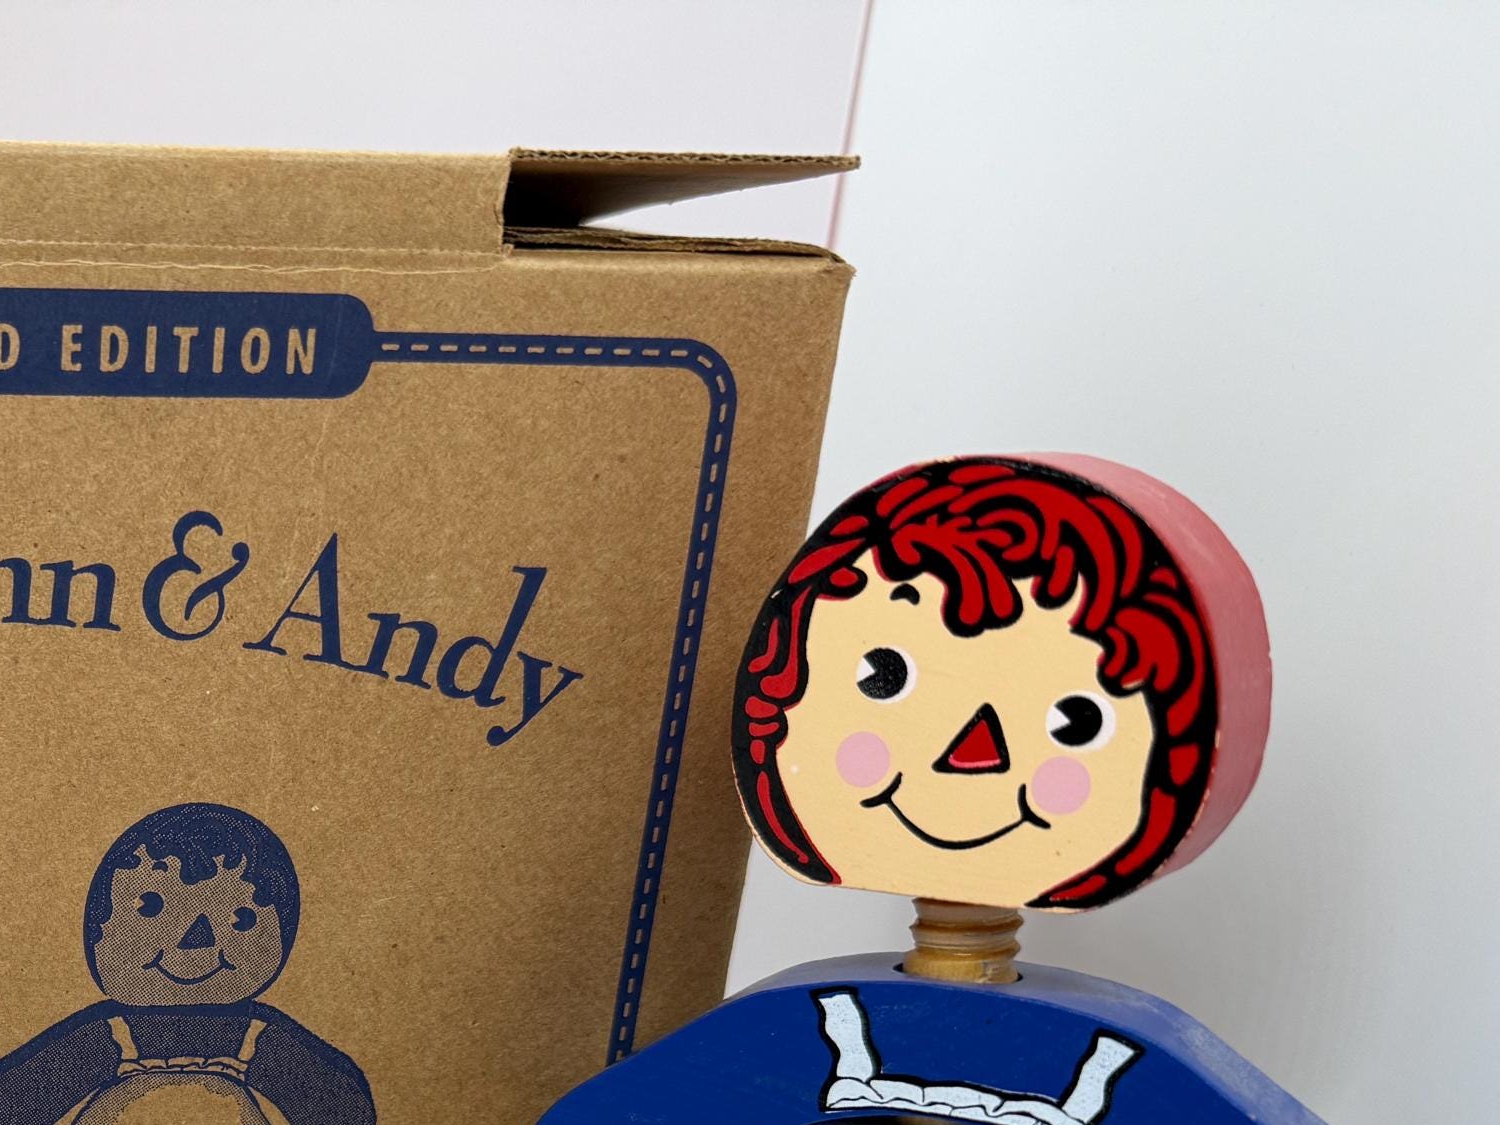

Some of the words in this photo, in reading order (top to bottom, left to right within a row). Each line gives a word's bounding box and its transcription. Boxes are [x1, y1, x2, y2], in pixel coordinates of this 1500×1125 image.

[61, 324, 318, 375] EDITION
[142, 511, 249, 641] &
[244, 533, 584, 746] Andy
